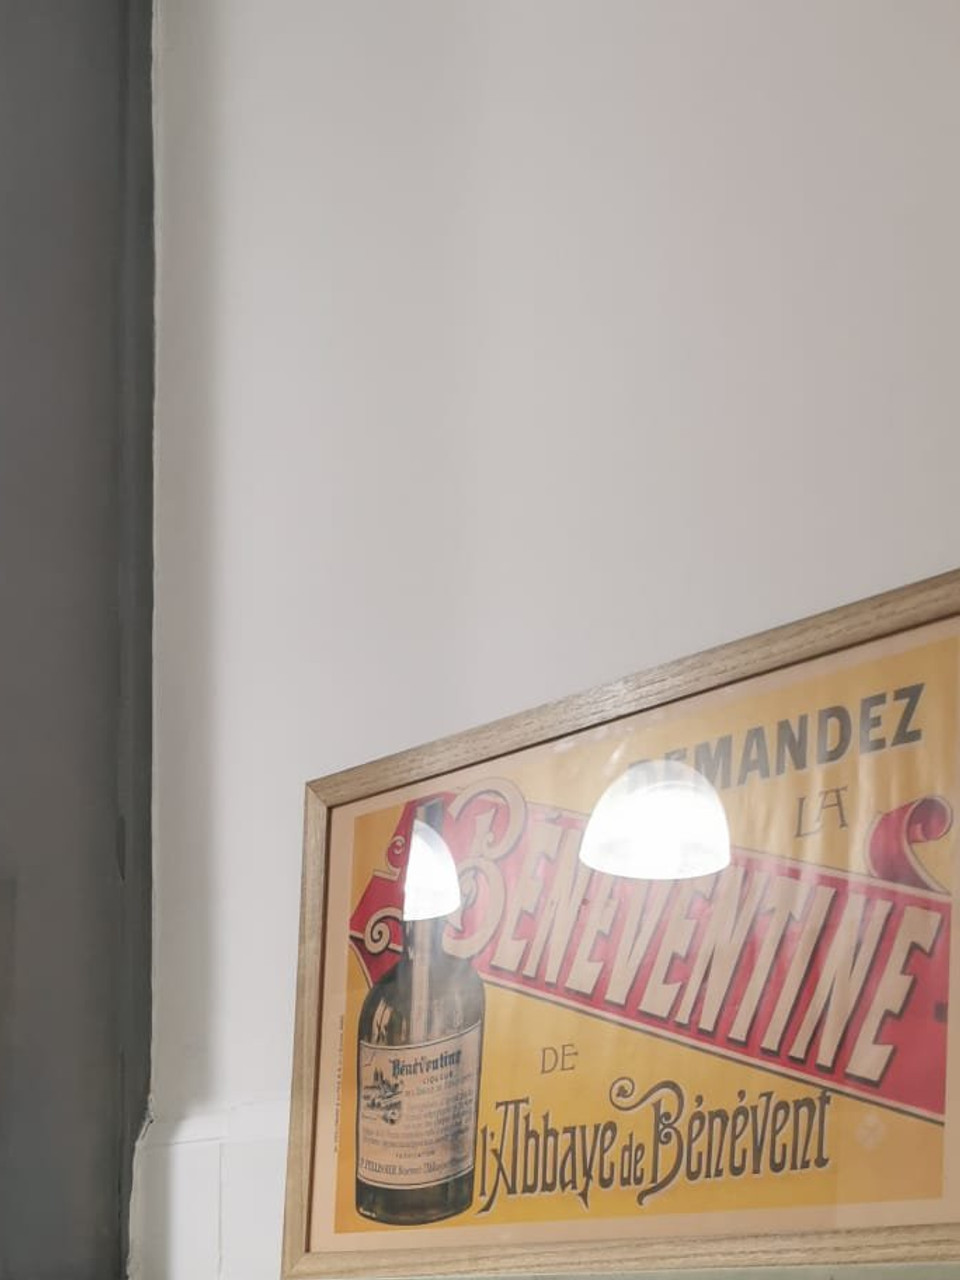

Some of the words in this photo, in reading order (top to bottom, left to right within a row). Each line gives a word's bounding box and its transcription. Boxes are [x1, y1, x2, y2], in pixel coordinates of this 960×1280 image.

[795, 786, 848, 838] LA
[540, 1043, 579, 1074] DE
[477, 1096, 617, 1213] l'Abbaye
[609, 1076, 832, 1206] Bénévent
[619, 1132, 645, 1187] de
